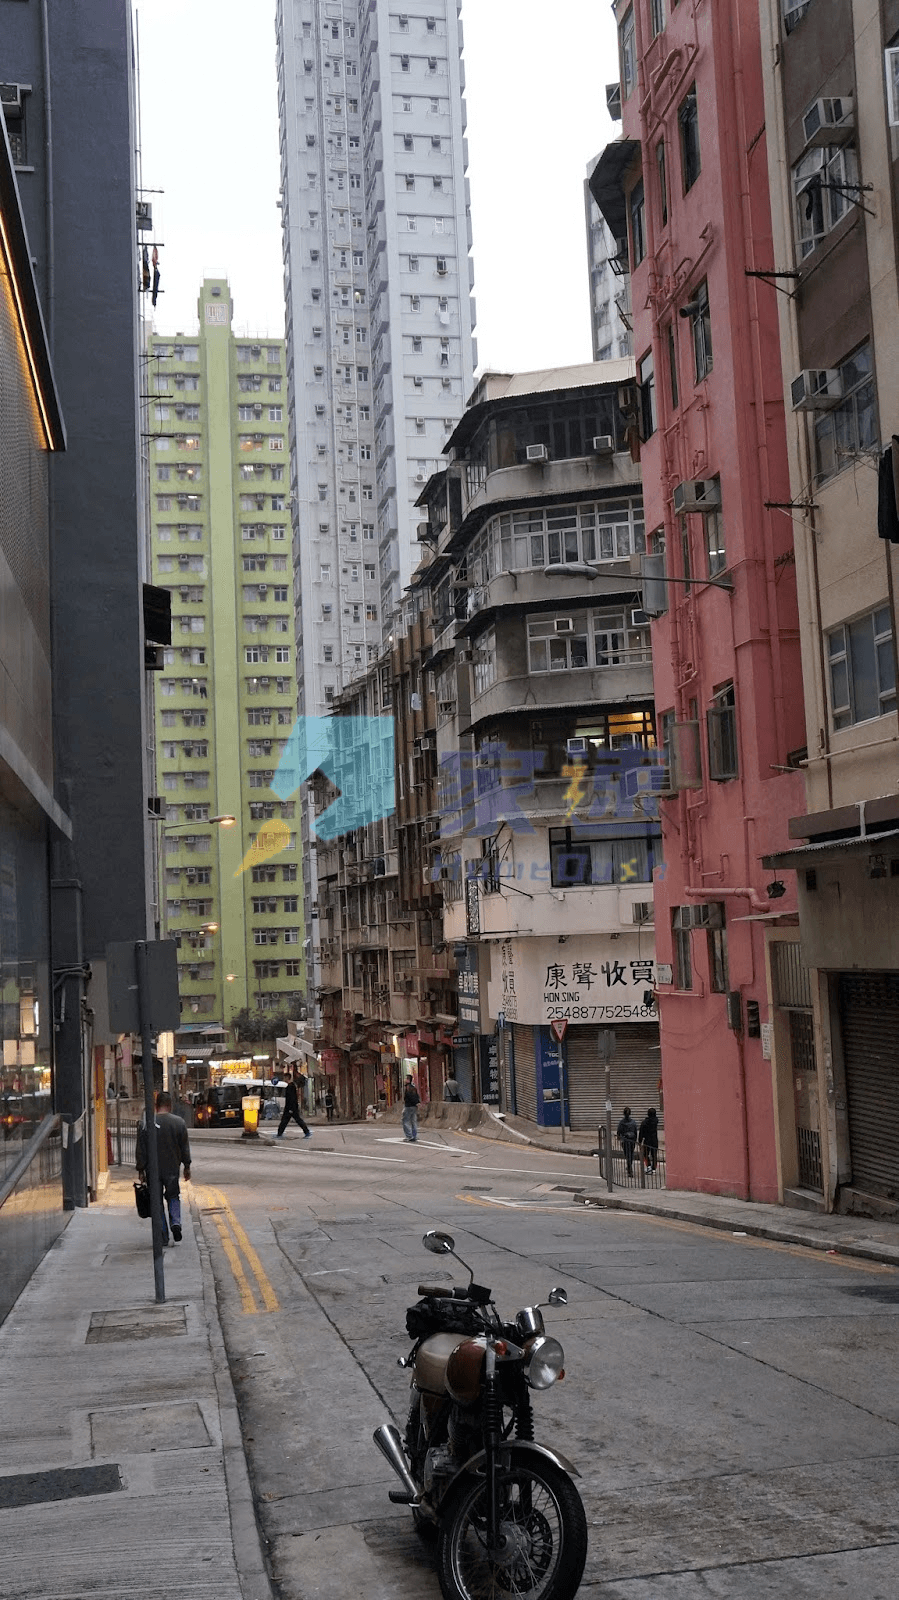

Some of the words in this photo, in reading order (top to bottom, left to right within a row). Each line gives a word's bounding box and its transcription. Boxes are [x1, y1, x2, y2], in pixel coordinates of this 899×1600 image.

[544, 960, 657, 991] 康聲收買
[543, 992, 560, 1003] HON
[561, 991, 580, 1002] SING
